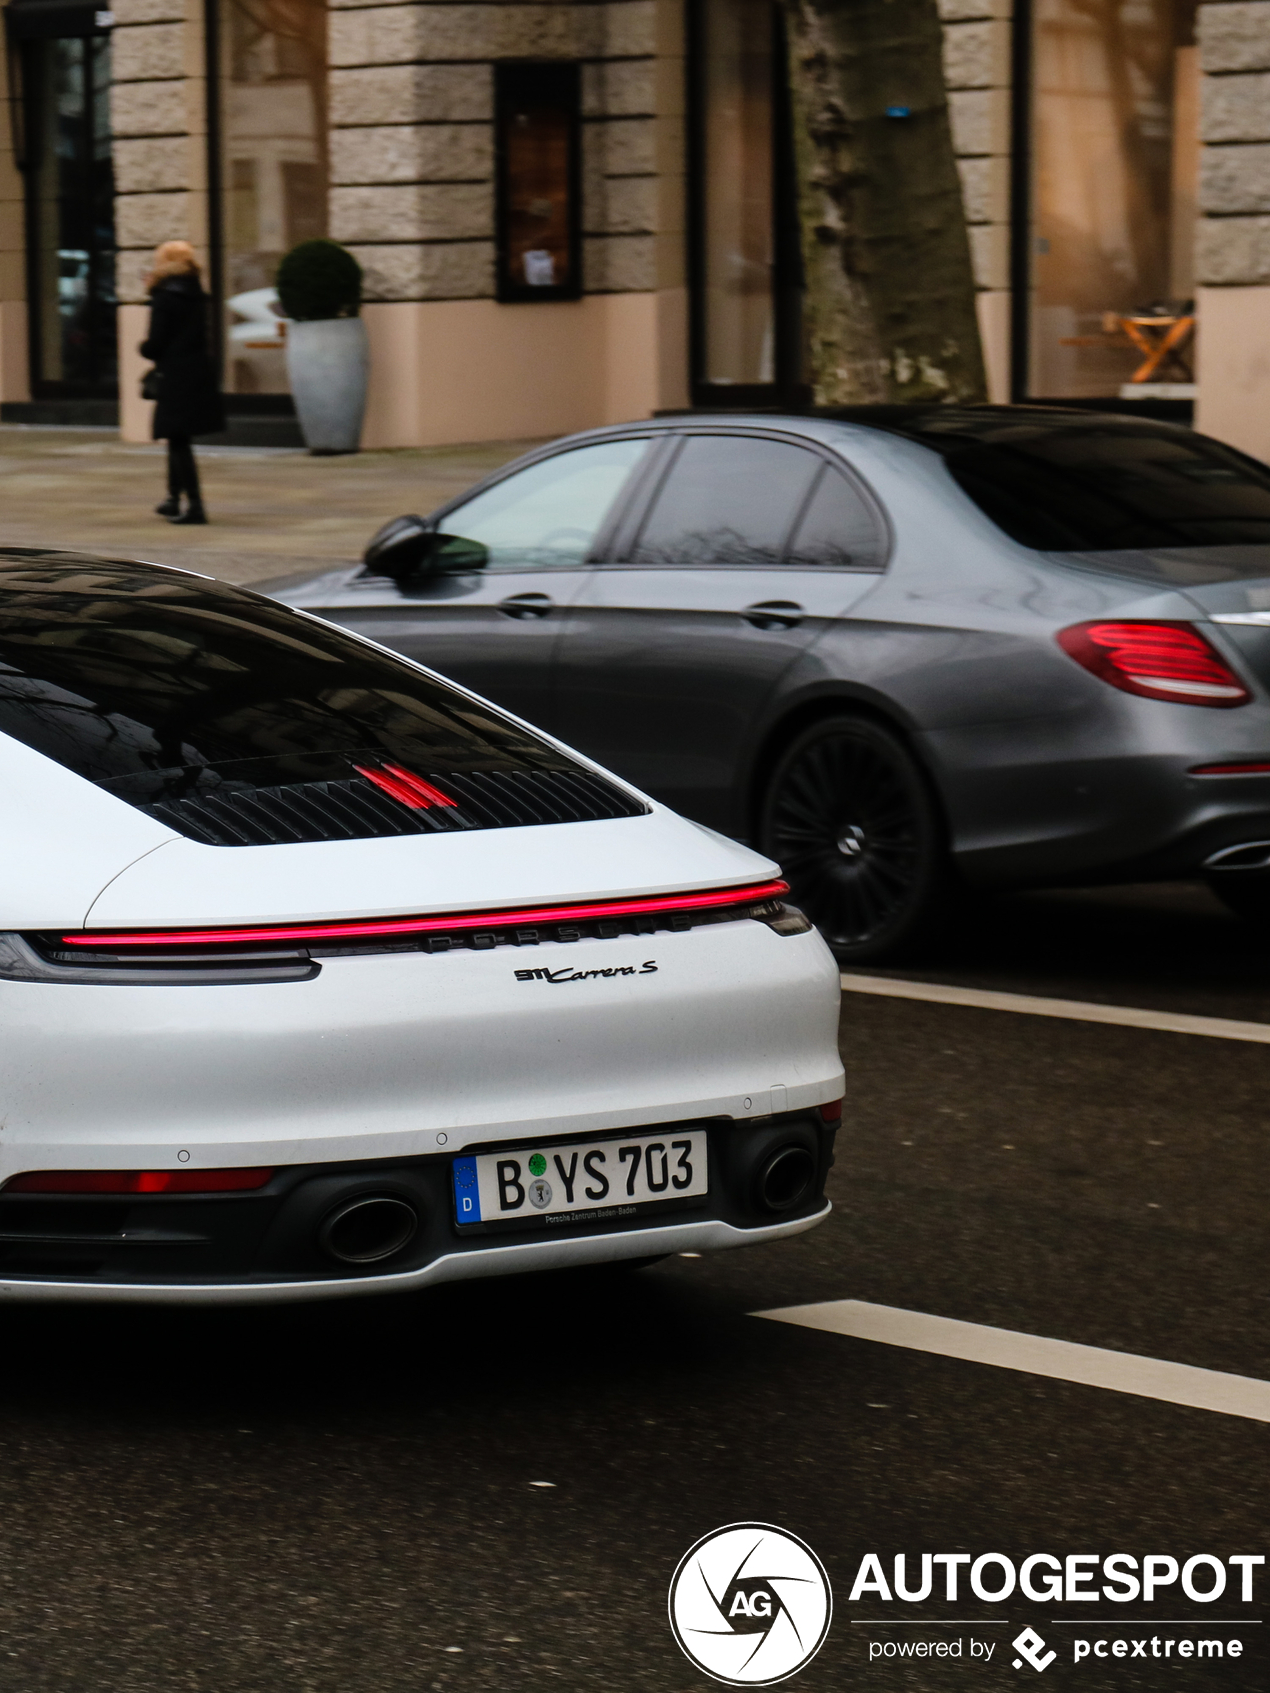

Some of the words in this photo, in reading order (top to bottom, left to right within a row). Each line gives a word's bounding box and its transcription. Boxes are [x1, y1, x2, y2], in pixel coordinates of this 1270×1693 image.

[514, 967, 549, 981] 911
[547, 965, 636, 984] Carrera
[638, 960, 659, 974] S
[496, 1159, 525, 1211] B
[463, 1197, 473, 1212] D
[545, 1213, 571, 1223] Porsche
[571, 1209, 597, 1221] Zentrum
[597, 1206, 637, 1218] Baden-Baden
